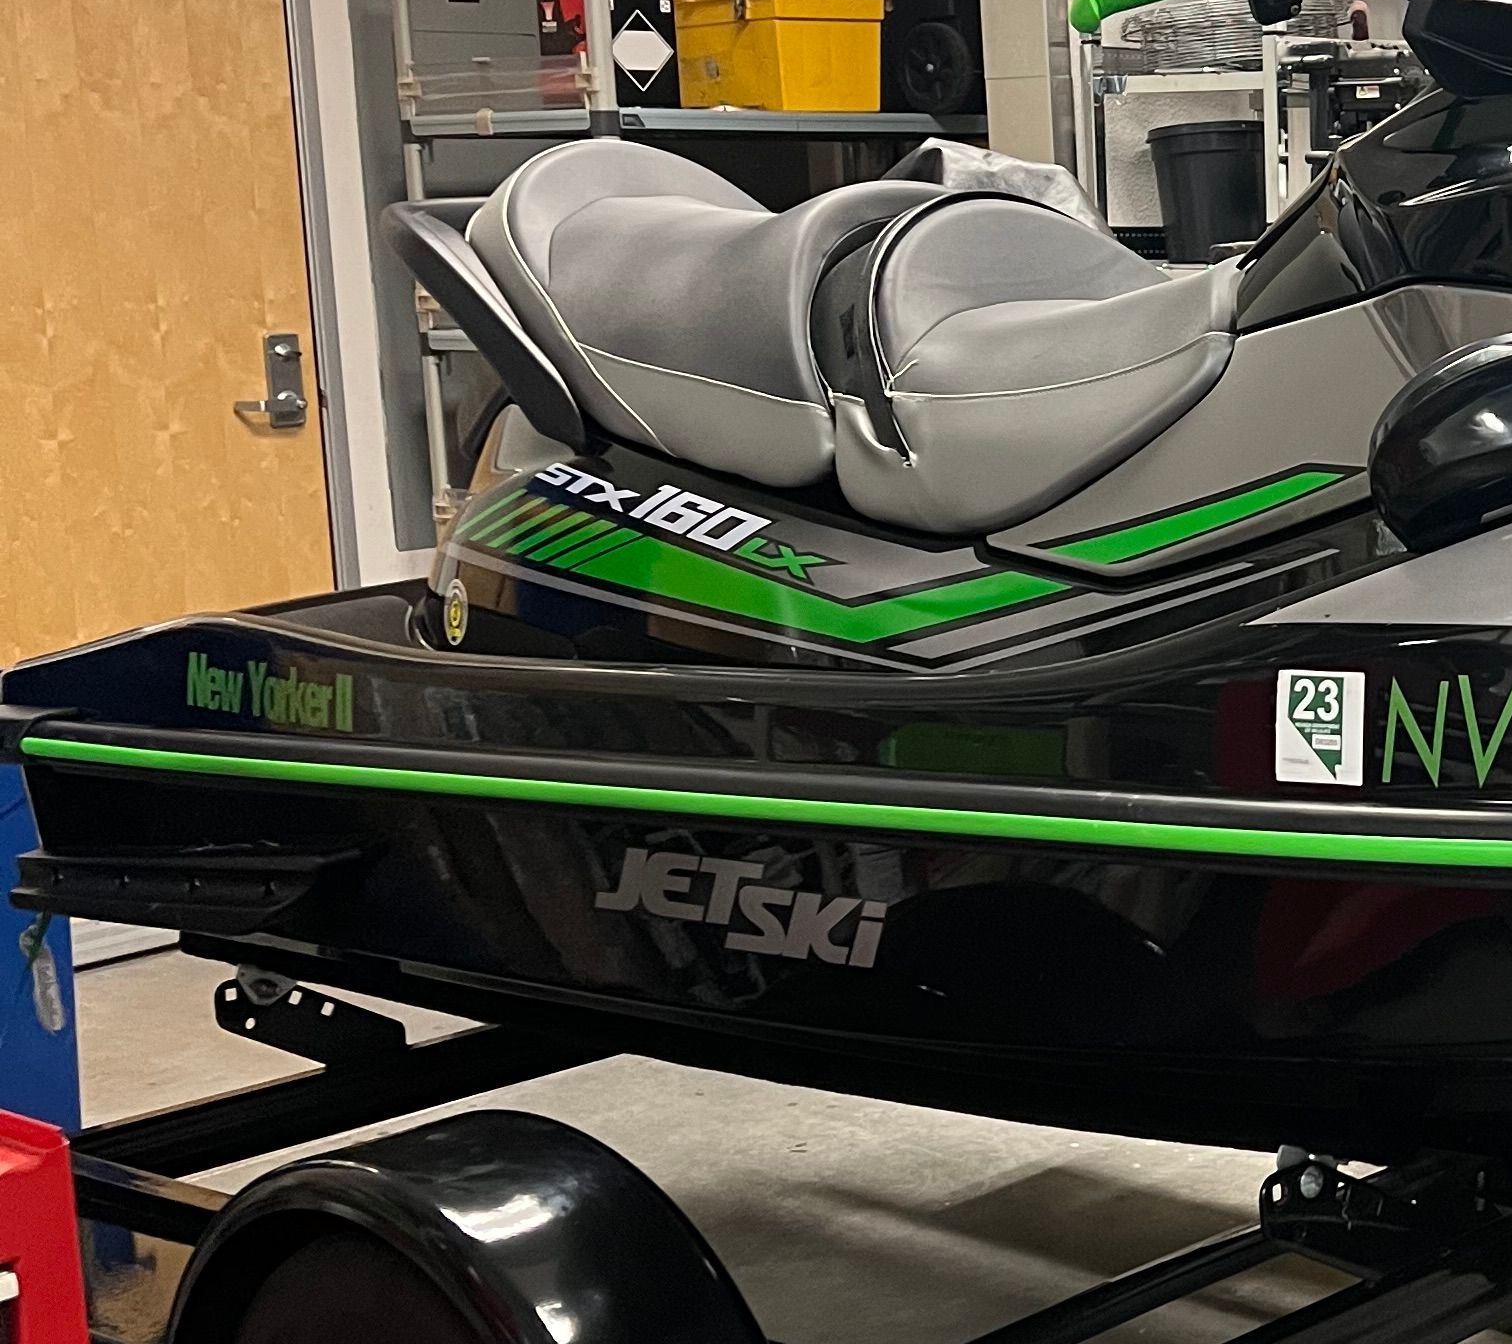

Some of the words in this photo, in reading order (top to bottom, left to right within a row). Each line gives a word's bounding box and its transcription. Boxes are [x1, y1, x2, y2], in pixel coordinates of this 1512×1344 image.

[534, 462, 641, 513] STX
[628, 484, 773, 551] 160
[733, 537, 828, 580] LX
[186, 651, 244, 714] New
[247, 660, 333, 728] Yorker
[1293, 678, 1340, 722] 23
